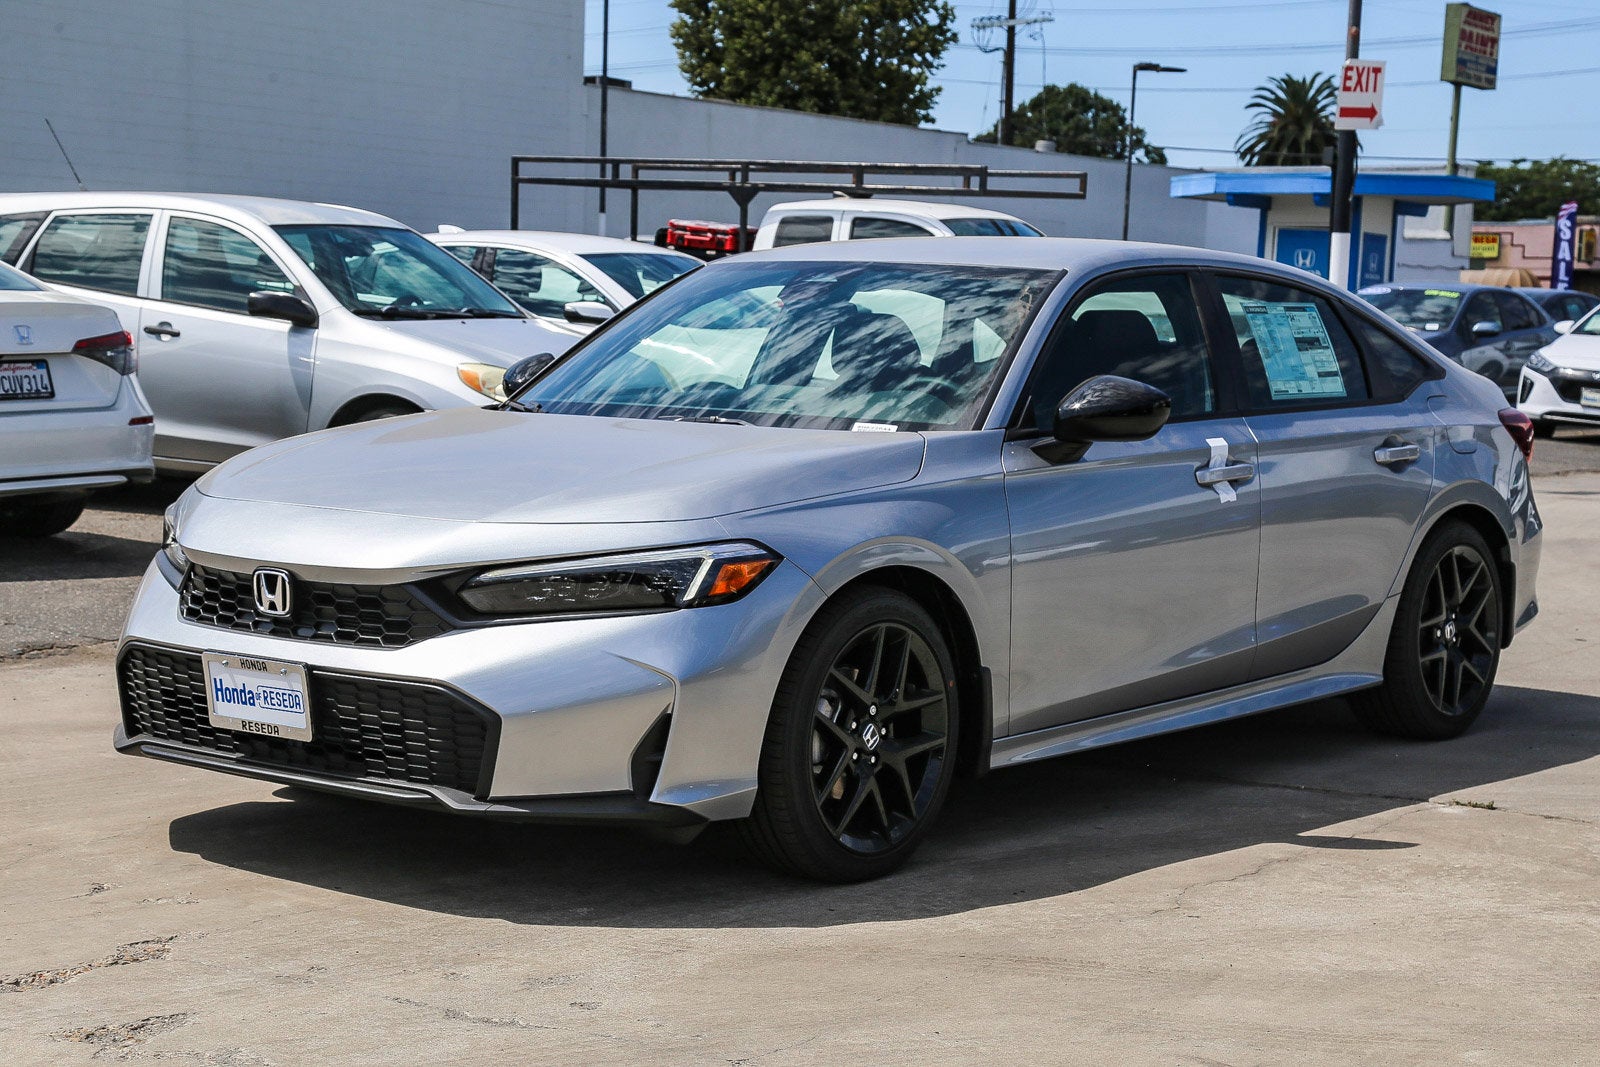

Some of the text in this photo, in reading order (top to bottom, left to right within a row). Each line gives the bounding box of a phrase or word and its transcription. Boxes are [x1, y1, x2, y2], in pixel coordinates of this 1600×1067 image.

[1342, 65, 1382, 93] EXIT
[240, 659, 268, 672] HONDA
[213, 677, 256, 707] Honda
[262, 690, 302, 710] RESEDA
[241, 720, 280, 736] RESEDA
